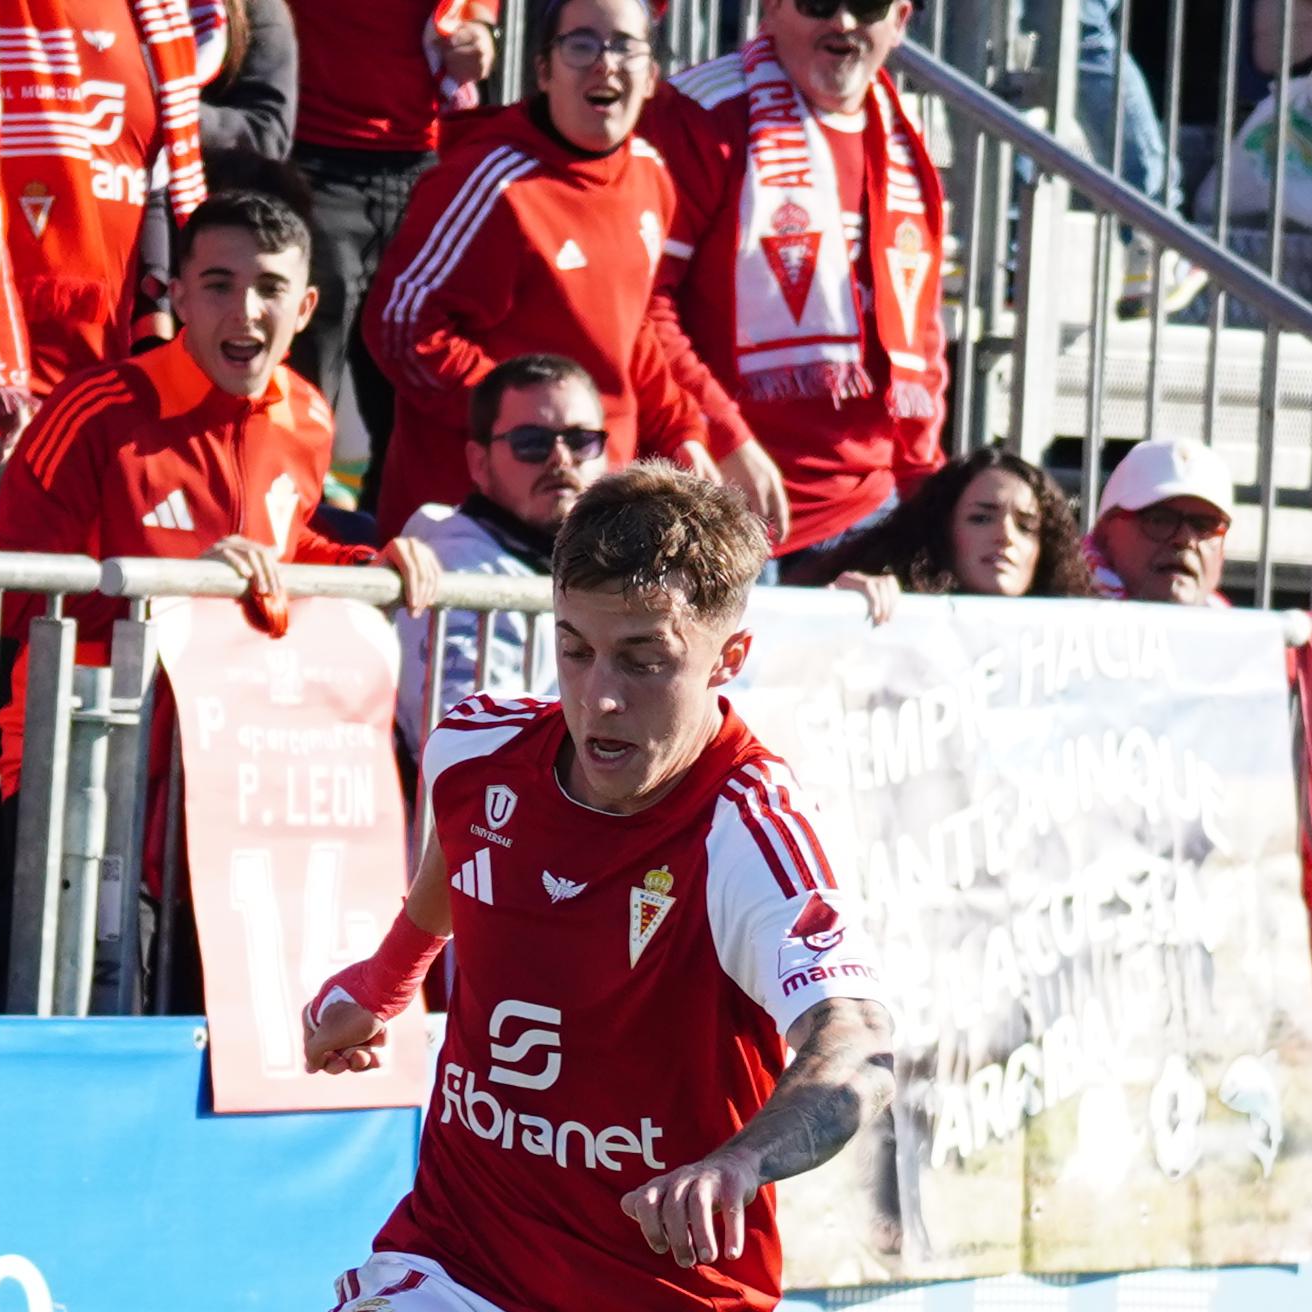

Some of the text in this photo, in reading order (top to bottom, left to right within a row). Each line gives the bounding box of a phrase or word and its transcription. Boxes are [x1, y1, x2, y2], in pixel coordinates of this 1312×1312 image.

[21, 85, 83, 101] MURCIA
[195, 697, 225, 751] P
[286, 764, 374, 827] LEON
[470, 823, 513, 849] UNIVERSAE
[440, 1062, 667, 1172] fibranet
